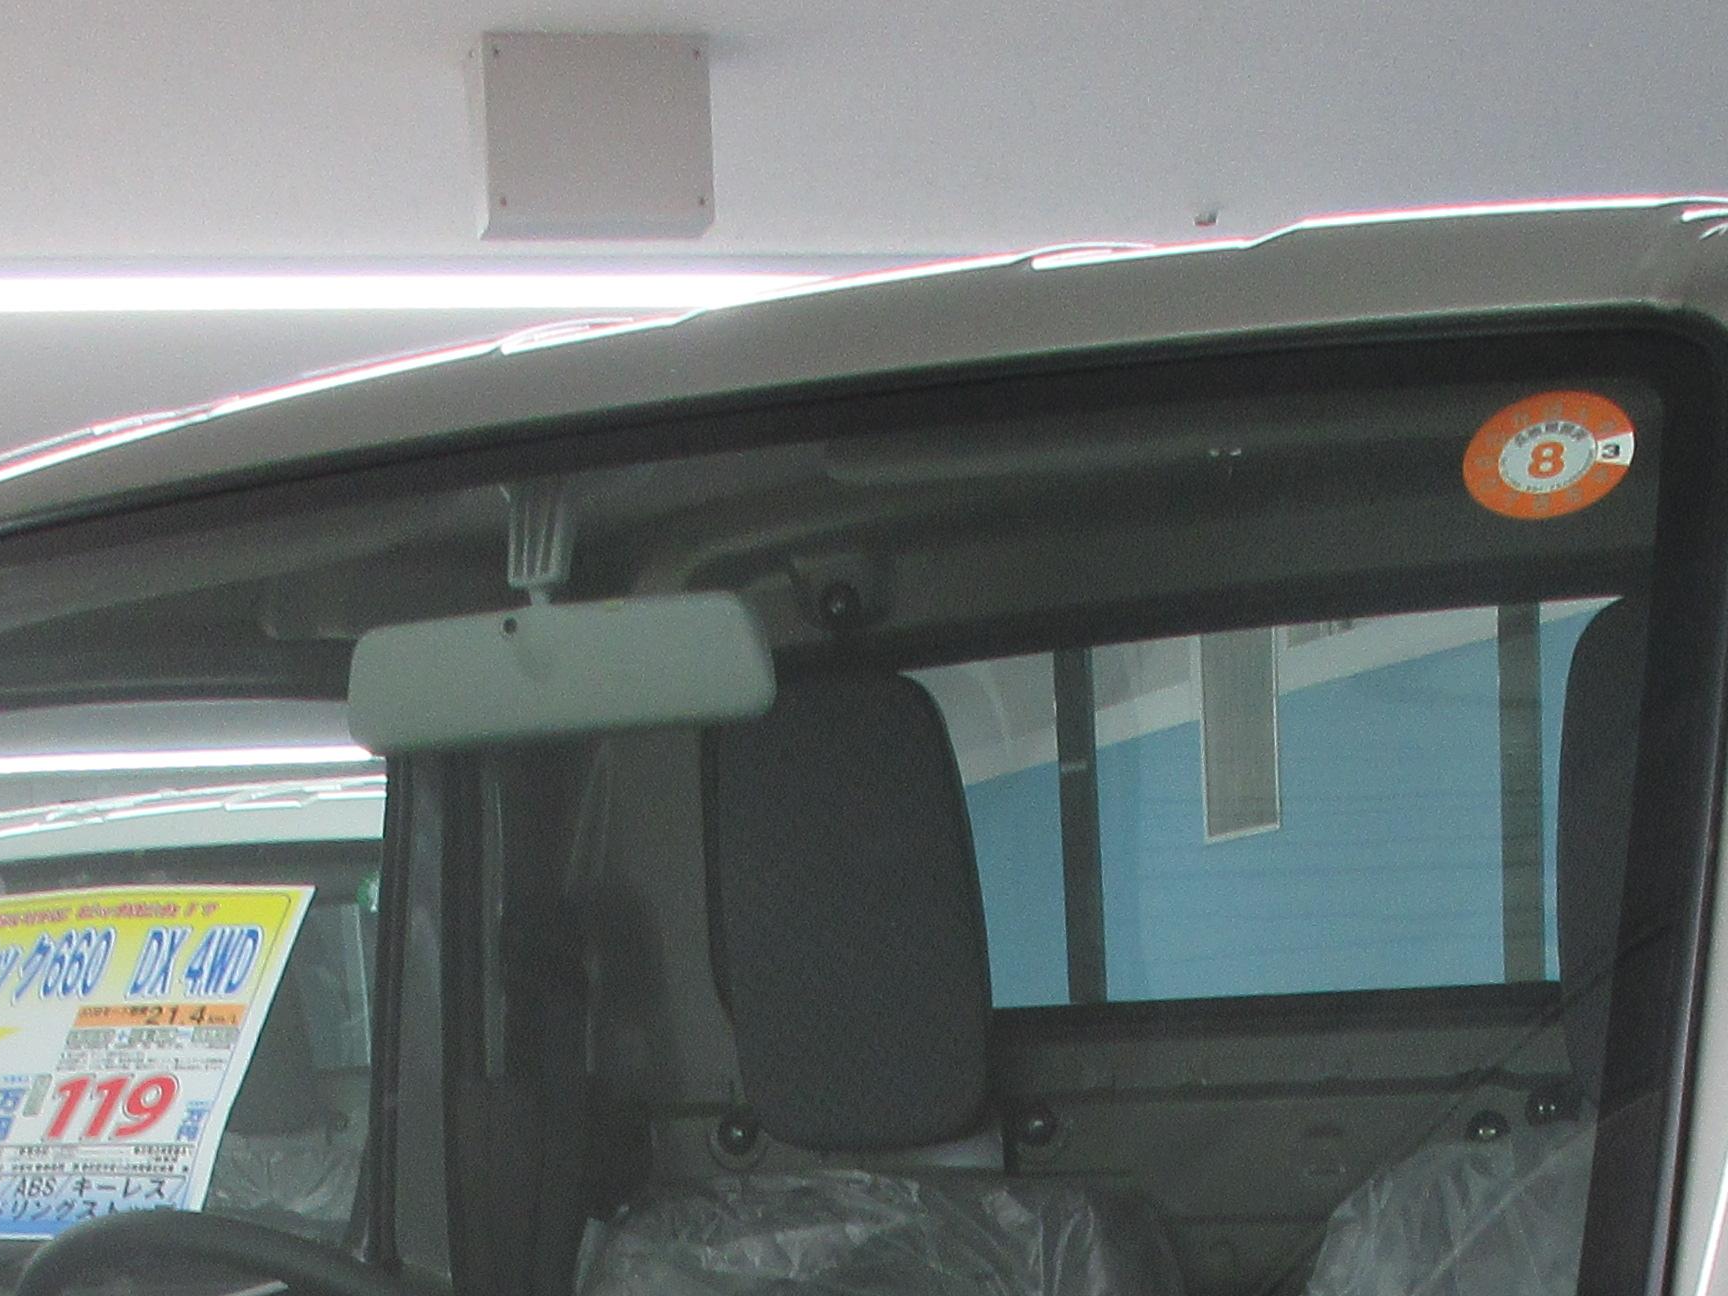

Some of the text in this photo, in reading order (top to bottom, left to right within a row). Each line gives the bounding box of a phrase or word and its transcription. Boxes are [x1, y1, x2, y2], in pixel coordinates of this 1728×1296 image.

[1528, 441, 1565, 479] 8
[1601, 443, 1621, 460] 3
[128, 927, 192, 996] DX
[184, 926, 263, 997] 4WD
[45, 1074, 180, 1140] 119
